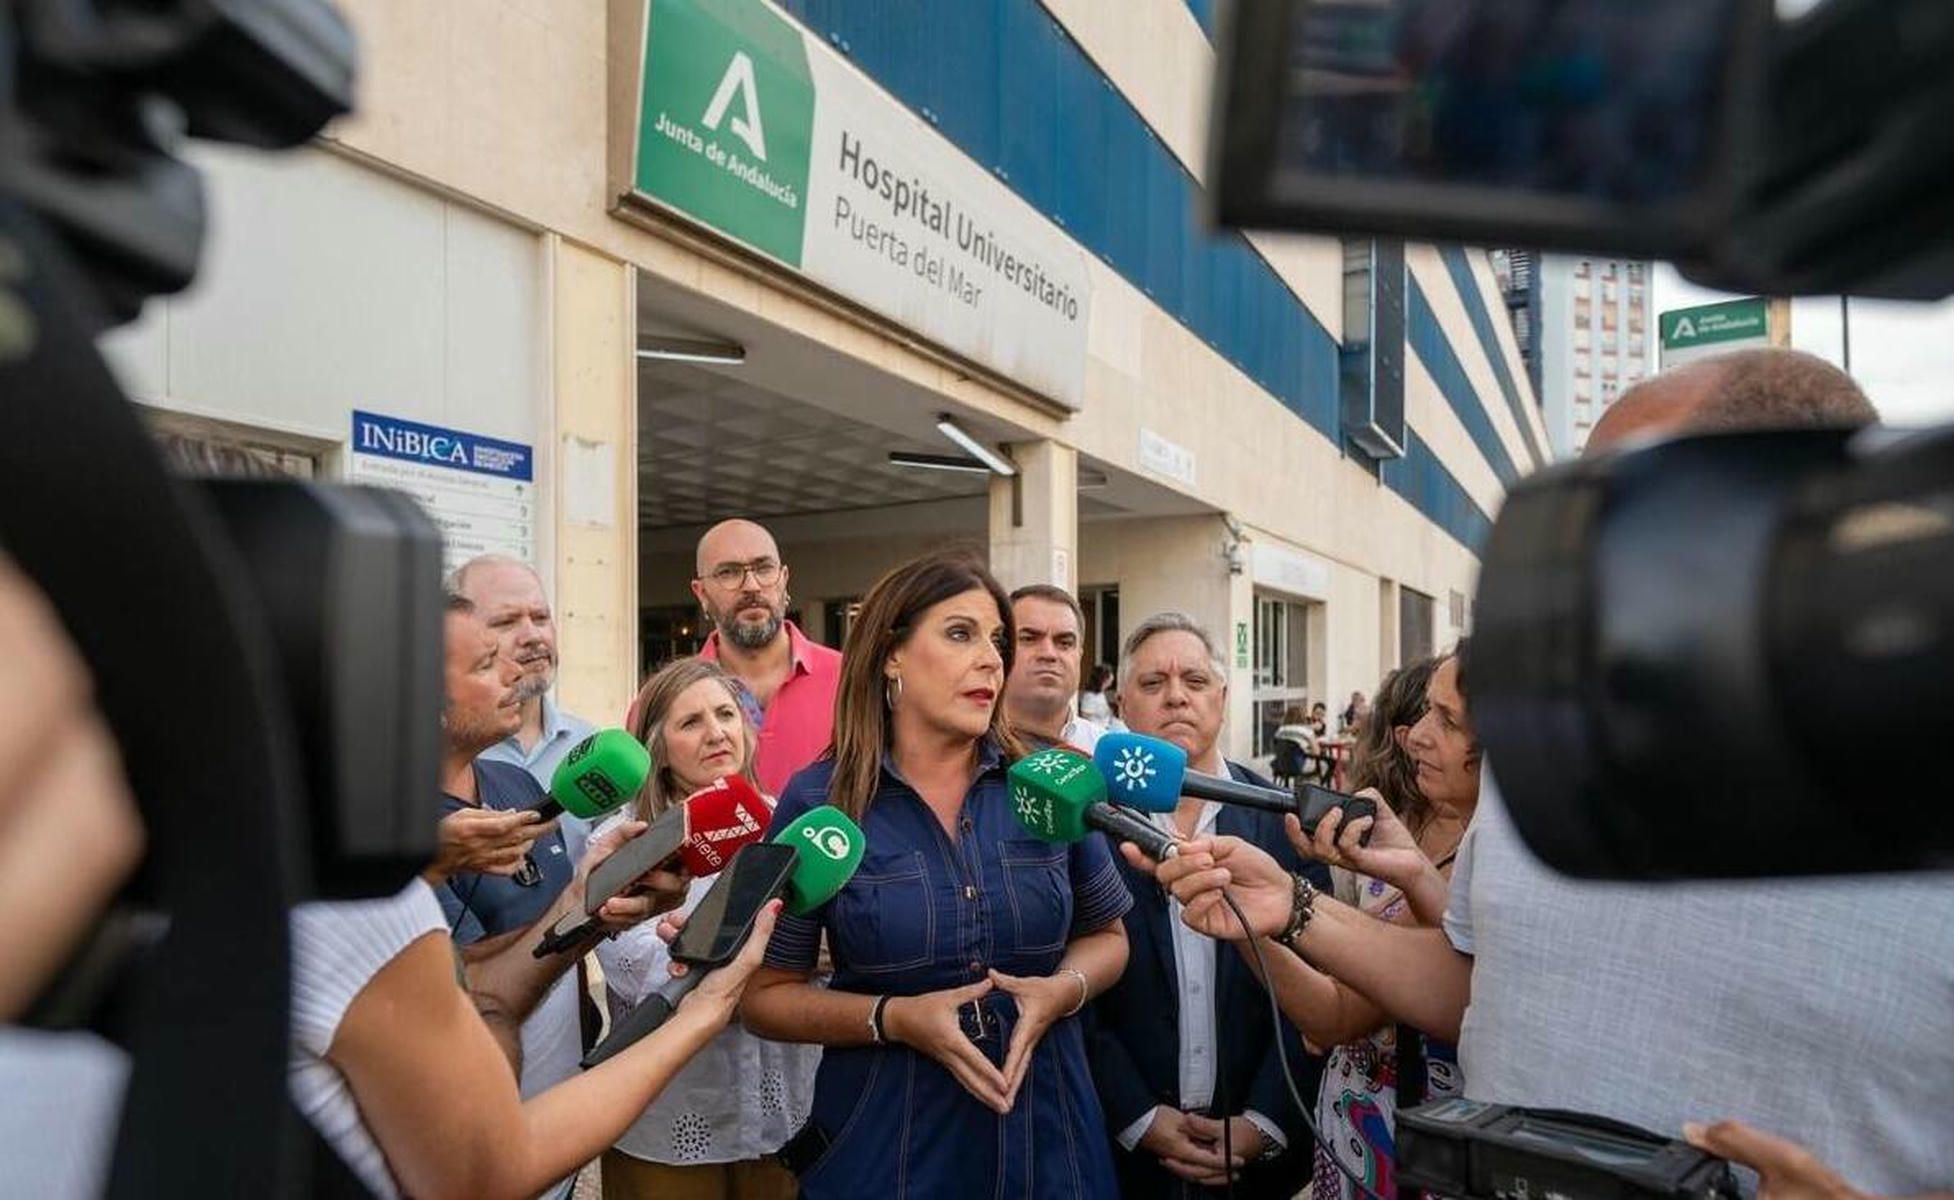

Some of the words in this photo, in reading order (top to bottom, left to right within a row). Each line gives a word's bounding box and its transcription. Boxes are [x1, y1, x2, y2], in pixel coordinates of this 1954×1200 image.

[655, 112, 703, 153] Junta
[705, 141, 727, 166] de
[727, 154, 798, 208] Andalucía
[834, 195, 909, 266] Puerta
[913, 246, 945, 288] del
[949, 265, 982, 309] Mar
[839, 130, 952, 240] Hospital
[957, 212, 1078, 321] Universitario
[361, 422, 469, 464] INiBICA
[692, 831, 722, 867] siete
